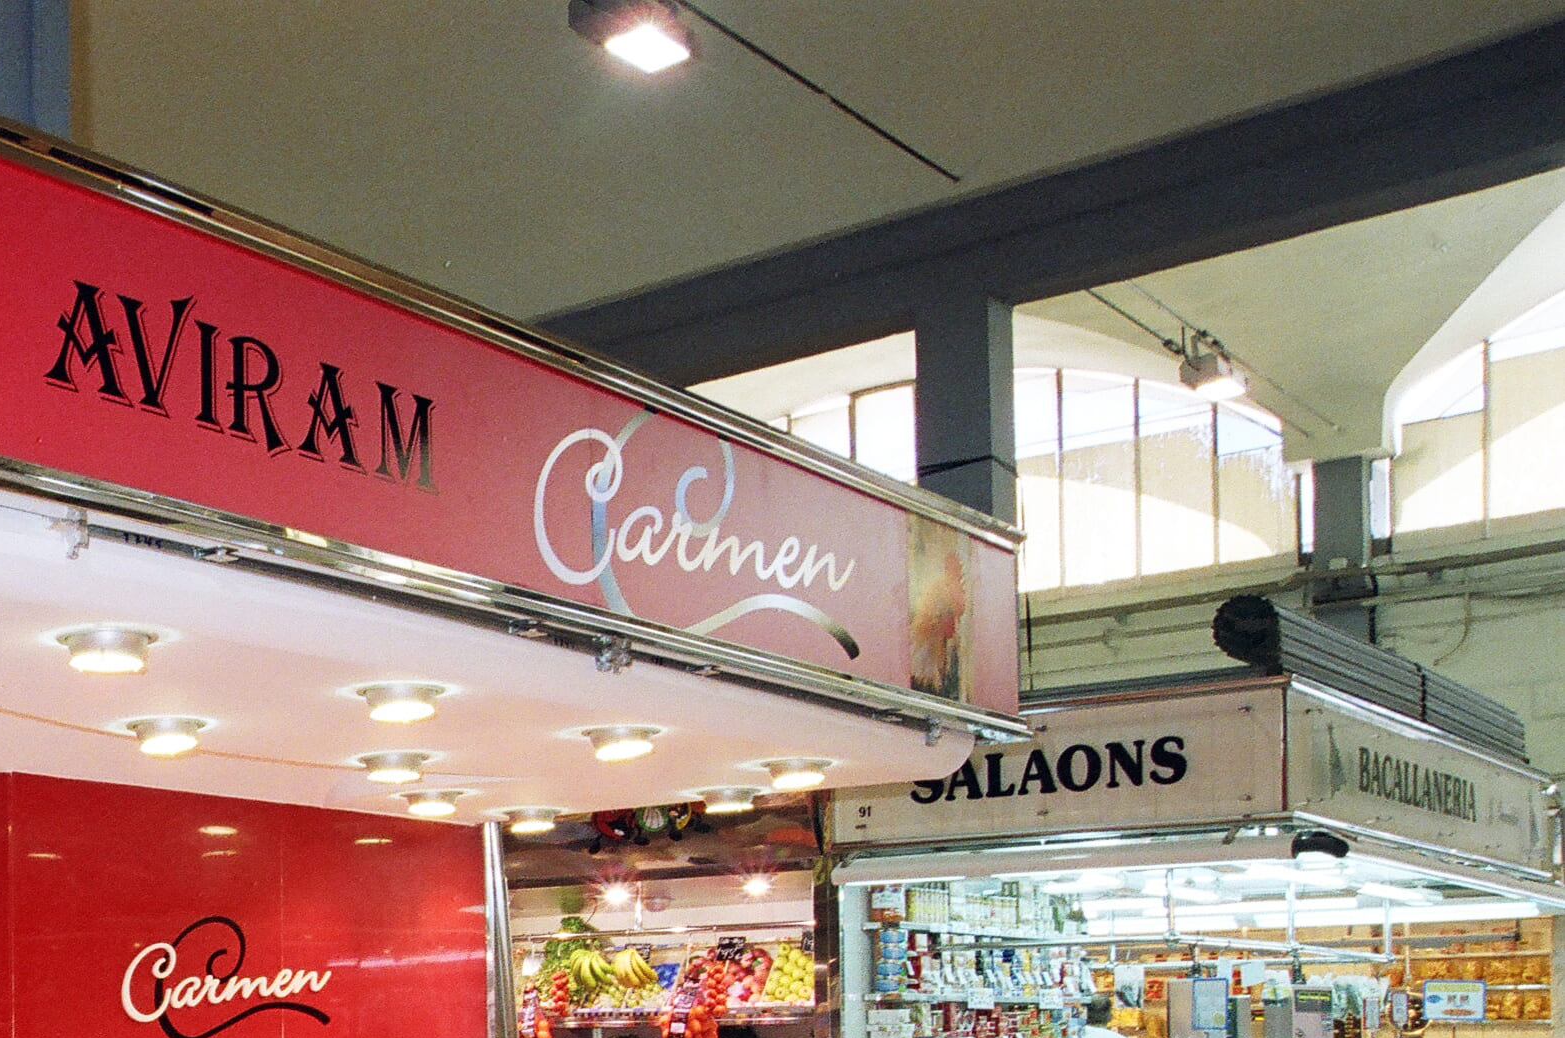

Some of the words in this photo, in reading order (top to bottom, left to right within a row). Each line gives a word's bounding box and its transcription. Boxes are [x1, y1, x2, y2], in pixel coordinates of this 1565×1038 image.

[43, 279, 439, 496] AVIRAM
[534, 427, 857, 593] Carmen
[858, 805, 872, 818] 91
[1358, 747, 1477, 823] BACALLANERIA
[121, 942, 333, 1024] Carmen
